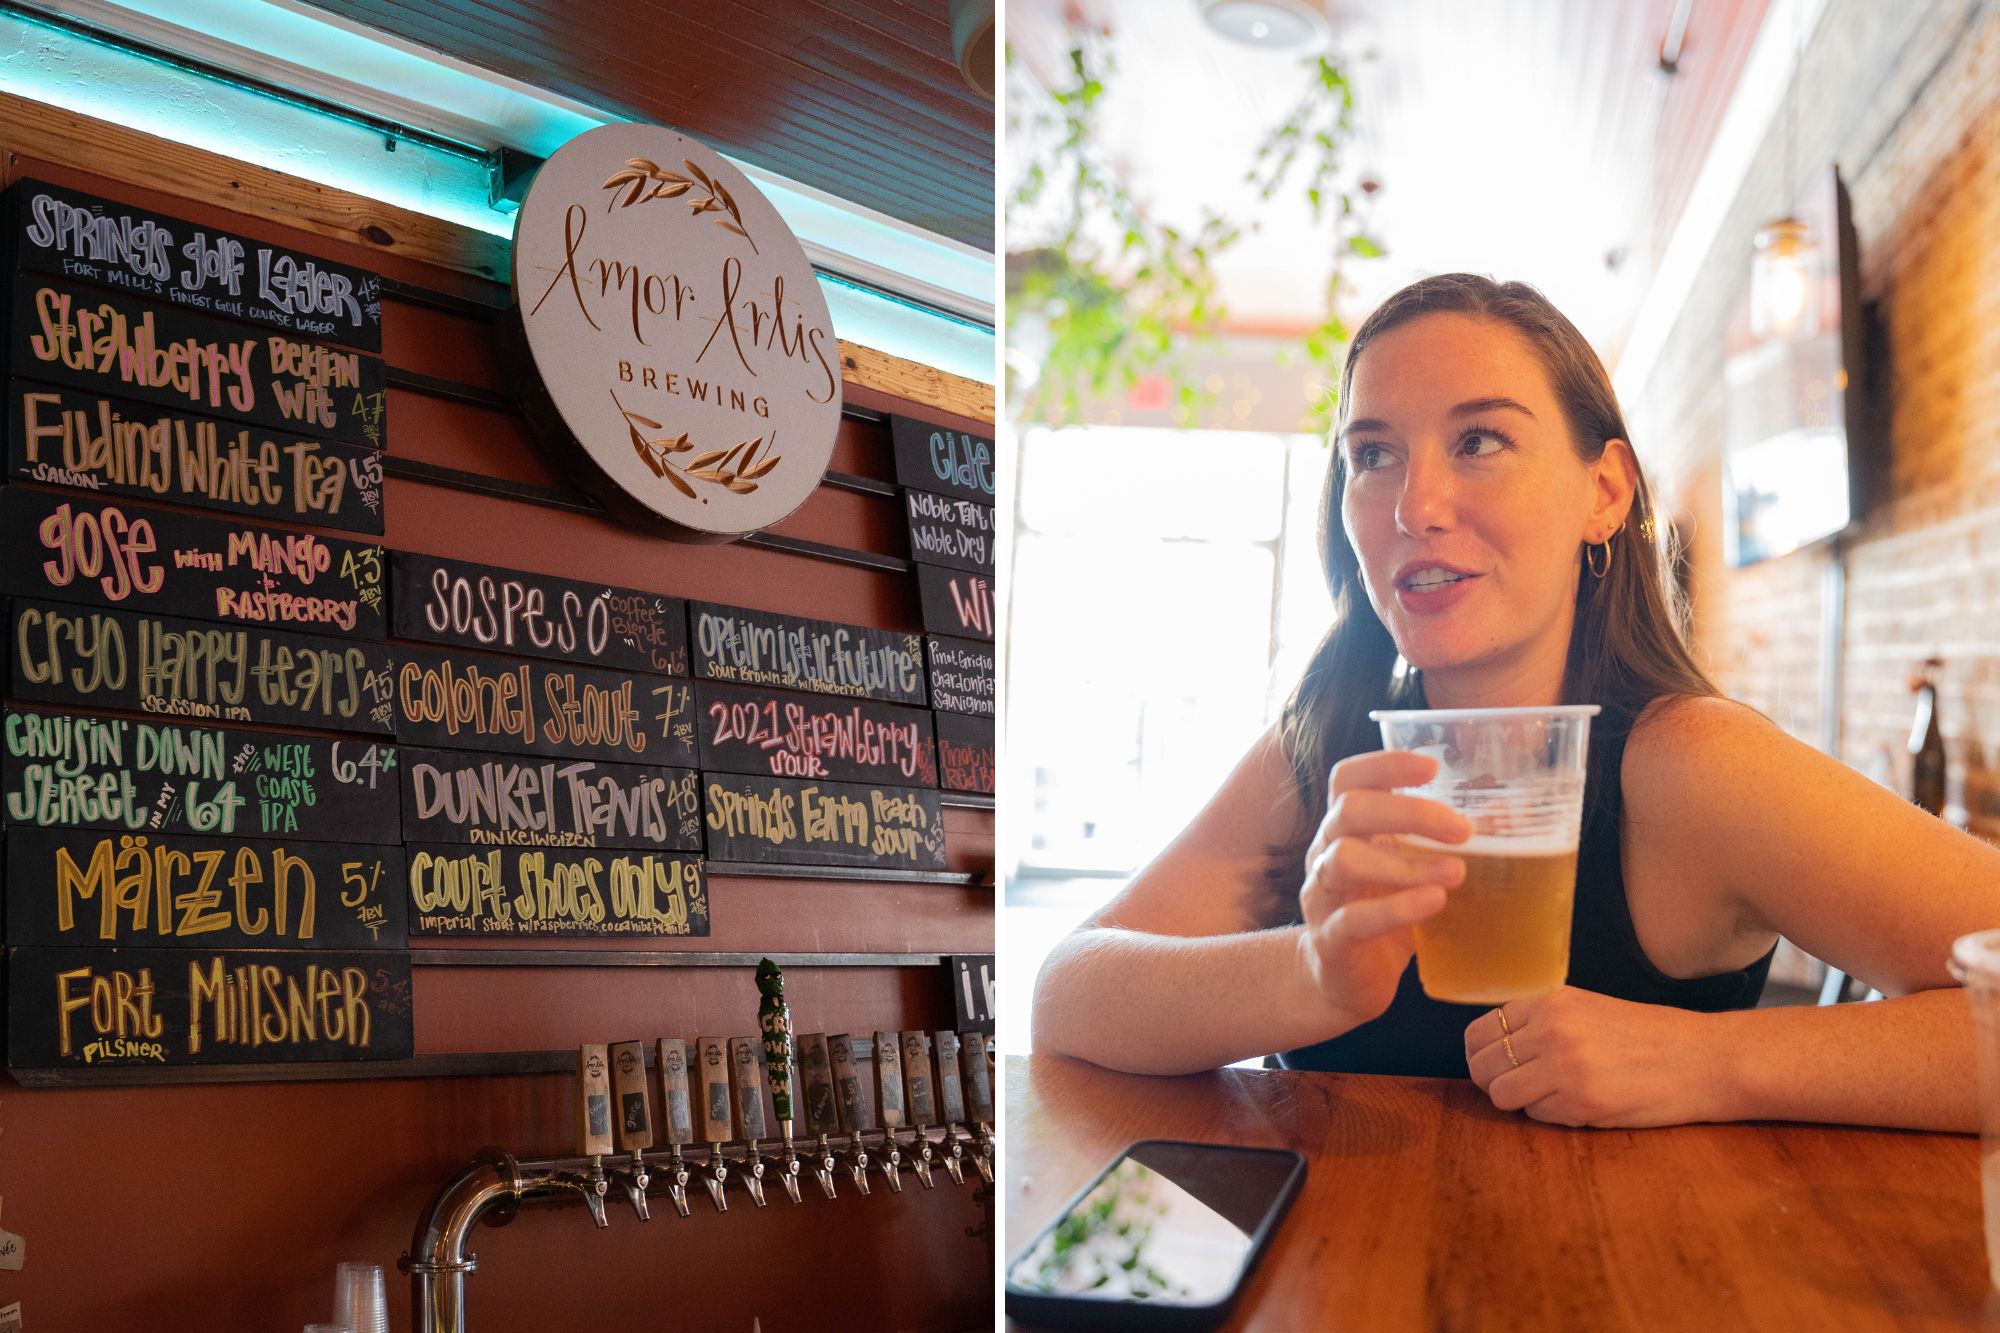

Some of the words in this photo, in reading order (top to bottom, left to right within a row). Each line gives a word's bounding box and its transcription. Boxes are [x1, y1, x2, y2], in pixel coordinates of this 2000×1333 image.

[63, 259, 101, 279] FORT
[107, 270, 163, 294] MILL'S
[169, 287, 212, 309] FINEST
[214, 294, 243, 317] GOLF
[249, 306, 292, 327] COURSE
[296, 317, 337, 336] LAGER
[530, 203, 694, 347] Amor
[696, 256, 836, 404] Artis
[30, 287, 258, 413] Strawberry
[618, 361, 769, 419] BREWING
[175, 419, 283, 505] White
[283, 441, 347, 514] Tea
[909, 493, 955, 523] Noble
[953, 501, 988, 531] Tart
[912, 525, 957, 555] Noble
[956, 528, 985, 565] Dry
[39, 502, 165, 602] gose
[18, 608, 128, 694] Cryo
[138, 619, 247, 707] Happy
[251, 638, 366, 718] tears
[707, 660, 737, 679] Sour
[739, 665, 782, 685] Brown
[929, 641, 957, 665] Pinot
[958, 650, 993, 679] Grigio
[932, 670, 995, 695] Chardonna
[224, 706, 252, 723] IPA
[400, 660, 534, 744] Colonel
[543, 673, 646, 750] Stout
[709, 700, 785, 749] 2021
[784, 702, 919, 778] Strawberry
[137, 725, 225, 781] DOWN
[232, 743, 255, 774] the
[263, 744, 315, 778] WEST
[331, 741, 397, 789] 6.4%
[557, 761, 667, 842] Travis
[706, 783, 797, 845] Springs
[801, 787, 869, 847] Farm
[870, 789, 927, 829] Peach
[56, 835, 316, 940] Märzen
[340, 860, 386, 907] 5%
[410, 849, 511, 922] Court
[513, 851, 605, 923] Shoes
[419, 913, 475, 934] imperial
